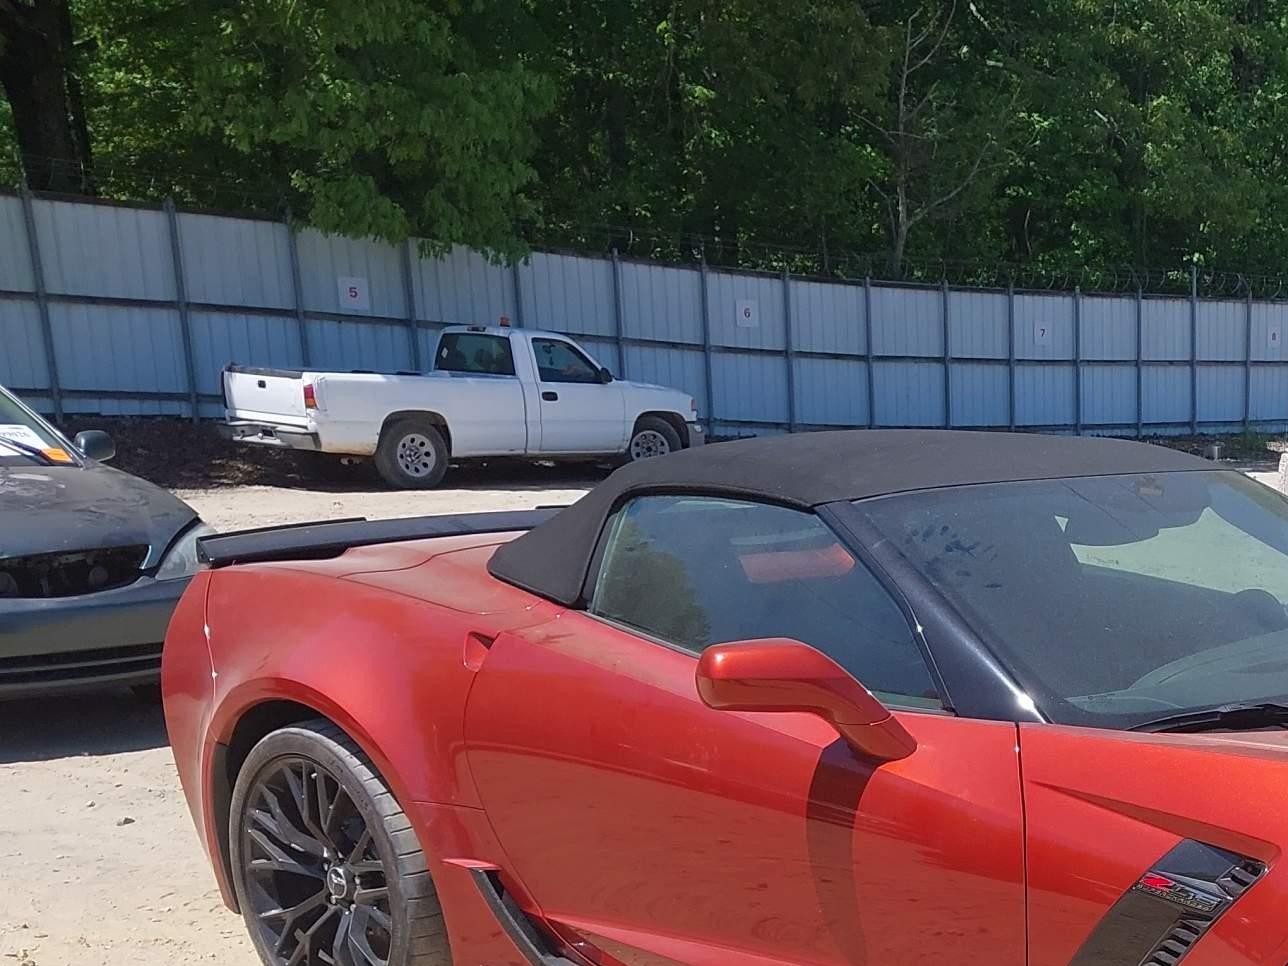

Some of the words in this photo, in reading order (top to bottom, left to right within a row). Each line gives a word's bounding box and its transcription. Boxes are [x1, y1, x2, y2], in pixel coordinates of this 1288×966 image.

[348, 287, 358, 298] 5
[743, 308, 751, 318] 6
[1039, 328, 1046, 338] 7
